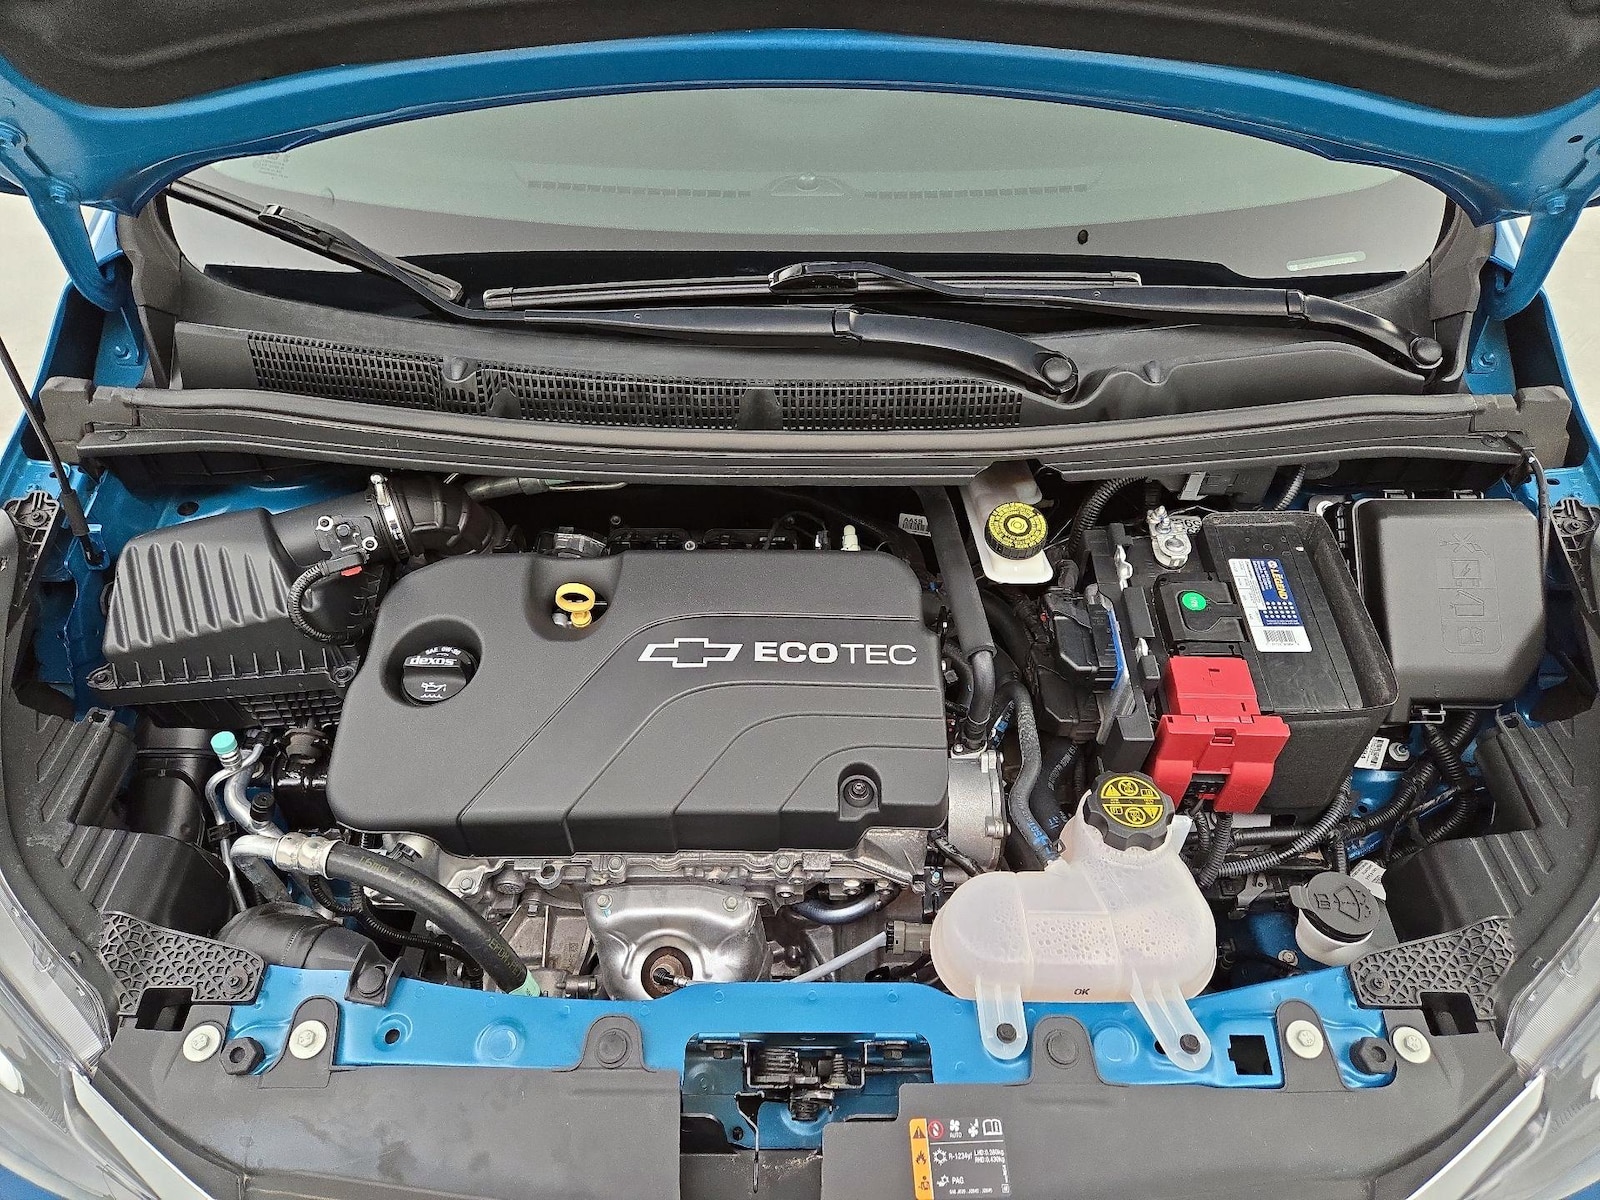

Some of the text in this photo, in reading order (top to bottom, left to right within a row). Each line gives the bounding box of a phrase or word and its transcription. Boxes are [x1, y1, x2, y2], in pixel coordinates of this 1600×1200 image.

[754, 641, 918, 665] ECOTEC
[409, 655, 458, 666] dexos
[1073, 988, 1090, 996] OK
[951, 1176, 965, 1185] PAG
